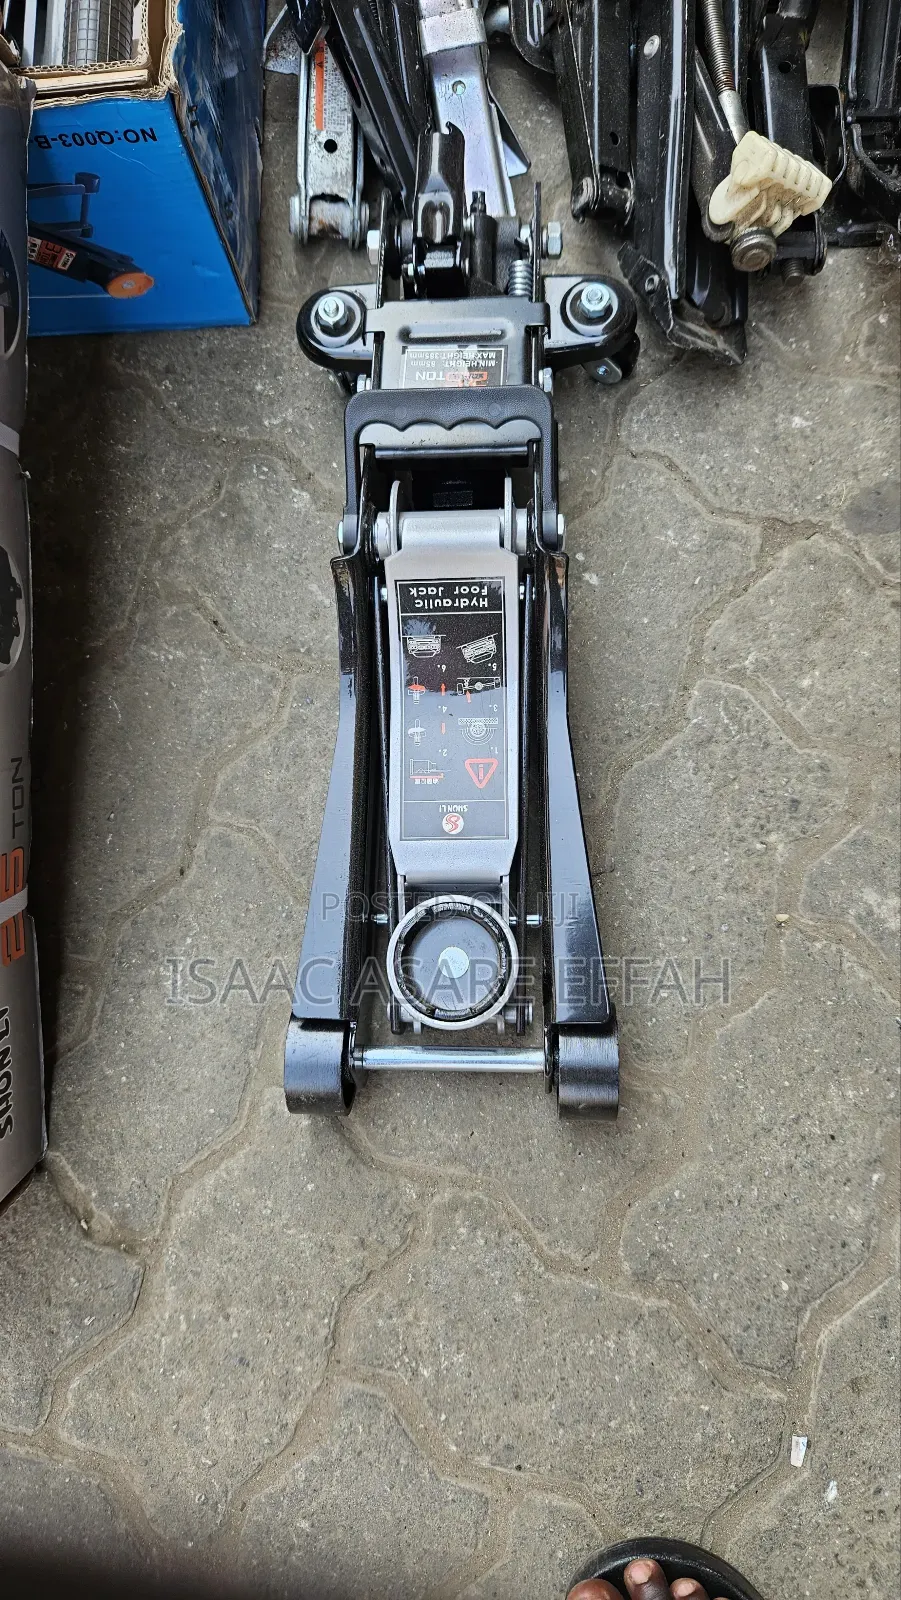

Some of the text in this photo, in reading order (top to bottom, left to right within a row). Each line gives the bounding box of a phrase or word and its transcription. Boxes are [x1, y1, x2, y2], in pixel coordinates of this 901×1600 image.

[415, 371, 445, 381] TON
[408, 585, 488, 597] Foor Jack
[414, 597, 488, 609] Hydraulic
[437, 664, 447, 673] 6.
[488, 662, 497, 671] 5.
[438, 705, 448, 713] 4.
[489, 704, 498, 712] 3.
[438, 748, 448, 757] 2.
[10, 757, 25, 839] TON
